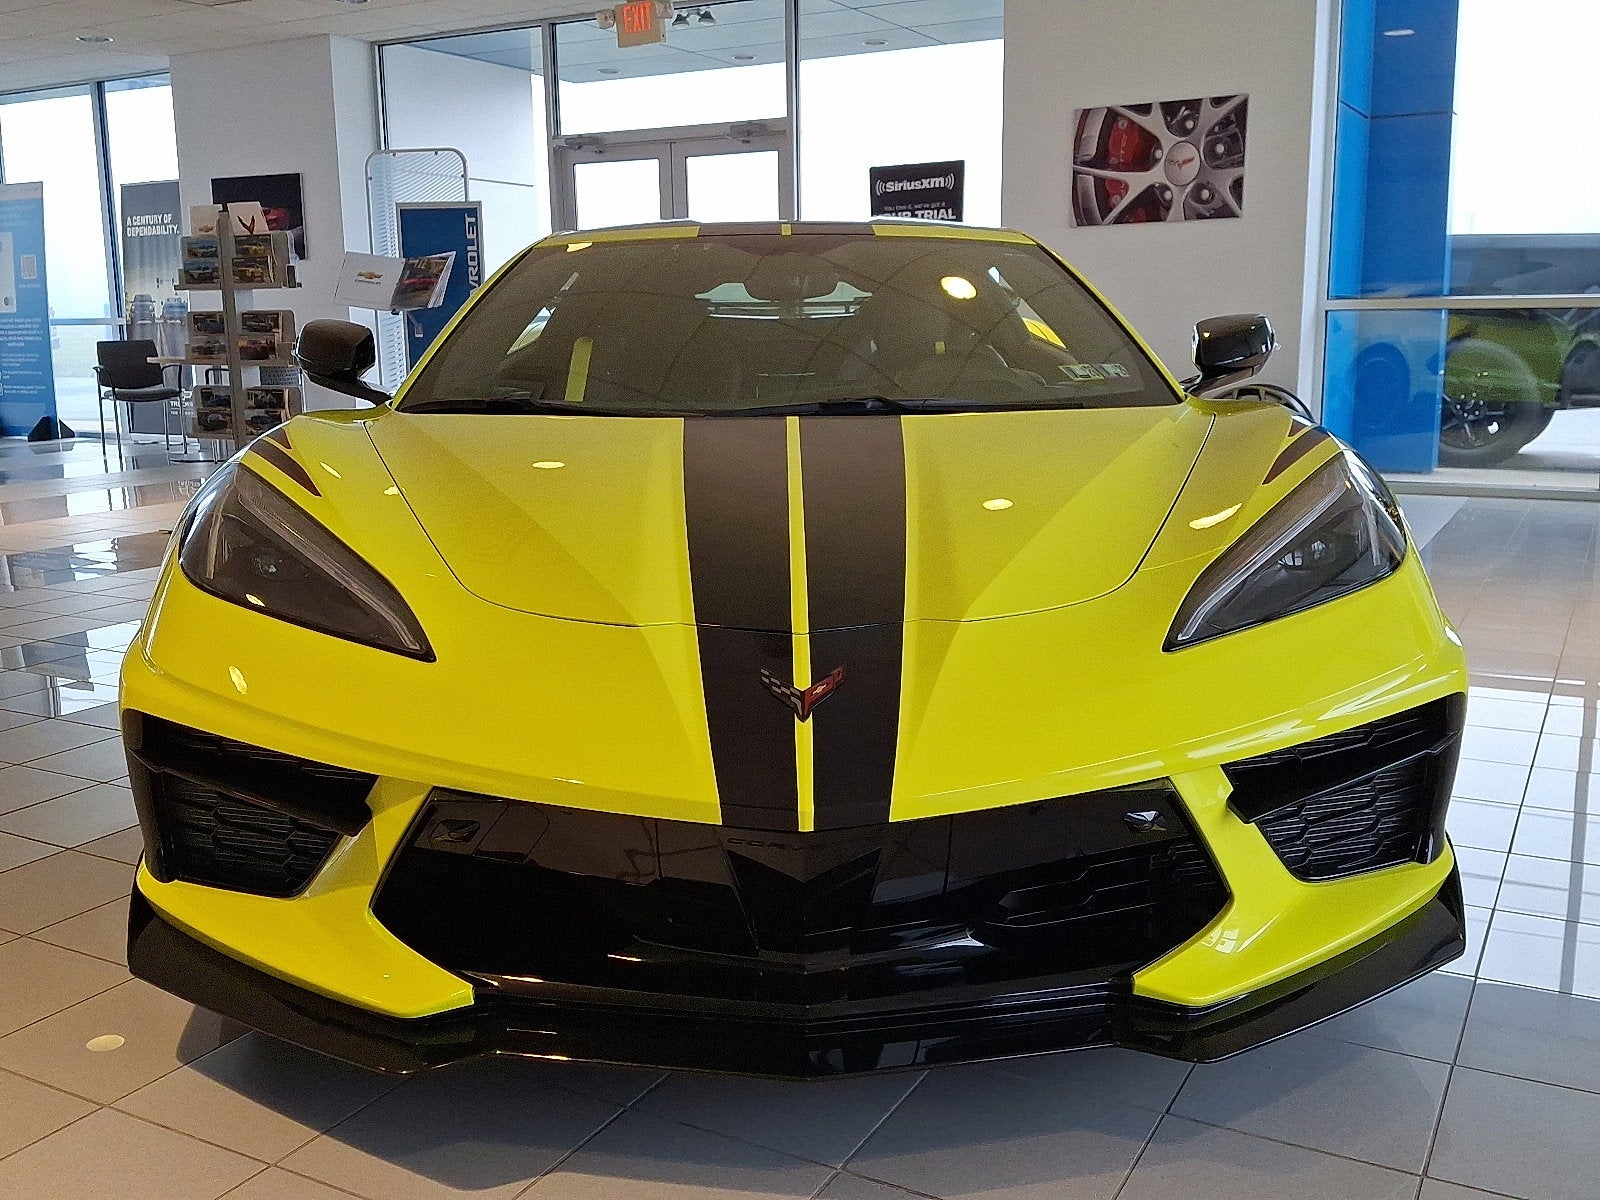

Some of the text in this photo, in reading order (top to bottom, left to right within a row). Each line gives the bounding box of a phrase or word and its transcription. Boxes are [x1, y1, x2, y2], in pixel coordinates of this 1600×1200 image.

[623, 2, 652, 33] EXIT
[126, 213, 172, 226] A CENTURY OF
[915, 208, 957, 220] TRIAL
[127, 224, 180, 237] DEPENDABILITY.
